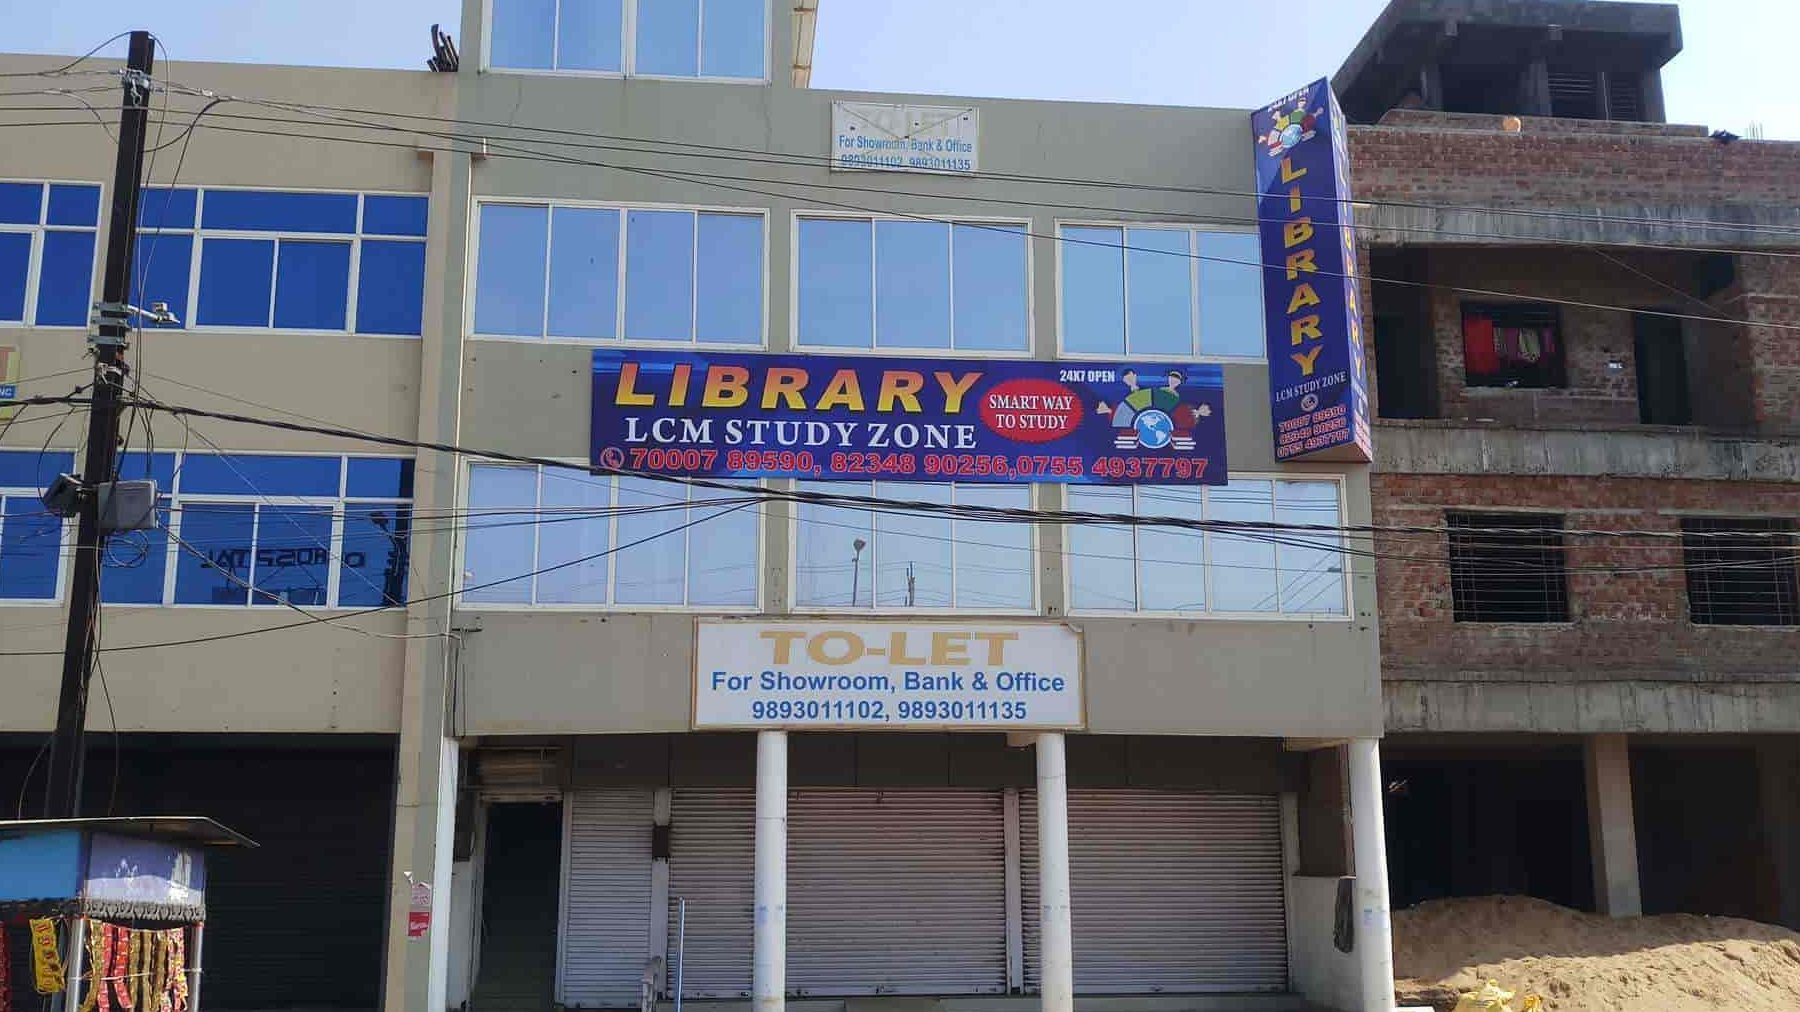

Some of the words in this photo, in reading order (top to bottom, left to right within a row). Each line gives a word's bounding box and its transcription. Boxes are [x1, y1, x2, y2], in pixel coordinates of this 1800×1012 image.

[838, 135, 854, 148] For
[911, 139, 933, 151] Bank
[936, 139, 943, 151] &
[945, 140, 973, 153] Office
[1280, 155, 1324, 377] LIBRARY
[615, 362, 983, 414] LIBRARY
[1059, 370, 1086, 383] 24X7
[1087, 370, 1115, 383] OPEN
[1276, 386, 1293, 402] LCM
[1294, 378, 1321, 395] STUDY
[1321, 371, 1347, 387] ZONE
[989, 394, 1039, 409] SMART
[1043, 396, 1073, 411] WAY
[624, 417, 713, 444] LCM
[724, 419, 858, 447] STUDY
[867, 423, 977, 449] ZONE
[995, 414, 1016, 429] TO
[1019, 415, 1068, 430] STUDY
[630, 448, 718, 470] 70007
[726, 450, 822, 479] 89590,
[831, 452, 916, 474] 82348
[1091, 456, 1209, 479] 4937797
[760, 630, 1019, 666] TO-LET
[711, 671, 753, 691] For
[760, 670, 895, 694] Showroom,
[904, 671, 964, 691] Bank
[971, 671, 989, 691] &
[995, 671, 1065, 692] Office
[752, 700, 890, 722] 9893011102,
[898, 700, 1027, 720] 9893011135
